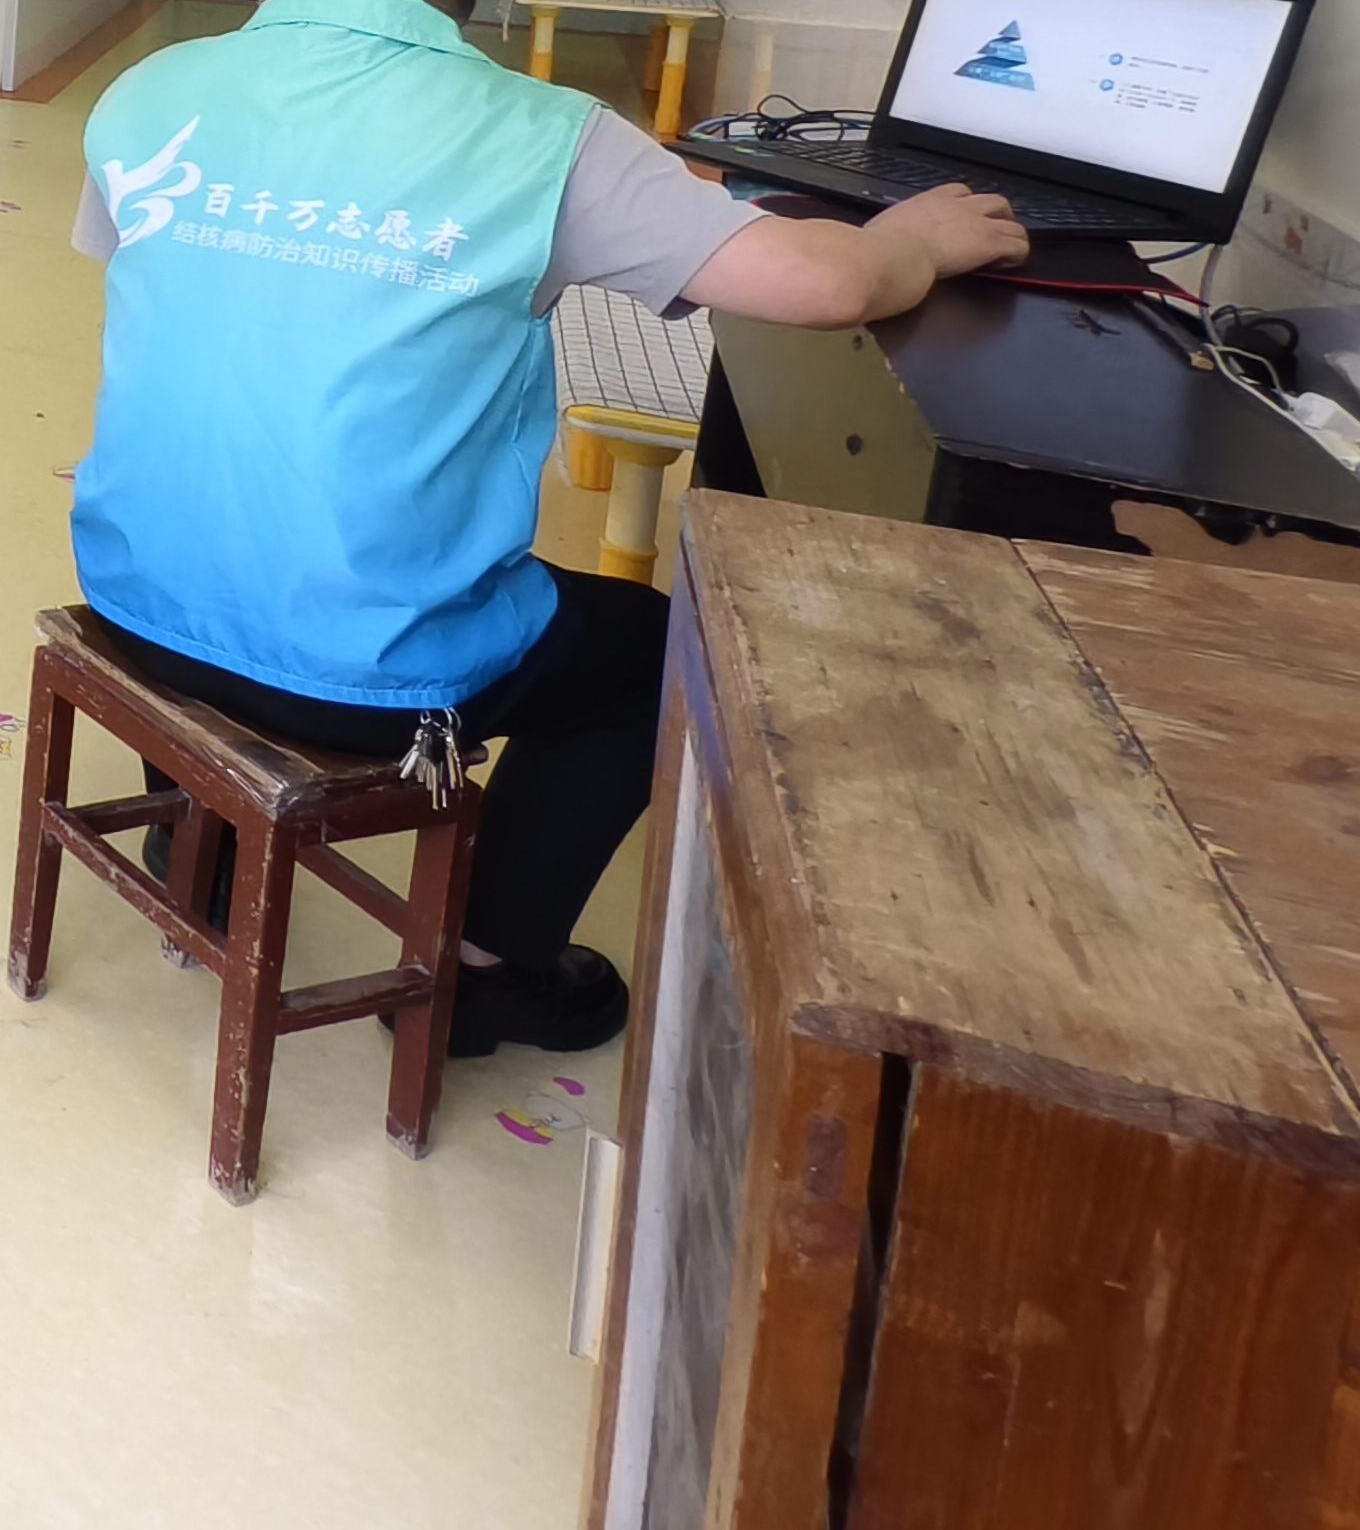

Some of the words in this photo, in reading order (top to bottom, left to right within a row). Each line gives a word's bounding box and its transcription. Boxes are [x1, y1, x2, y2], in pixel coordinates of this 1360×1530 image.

[170, 219, 480, 298] 结核病防治知识传播活动
[202, 182, 470, 263] 百千万志愿者
